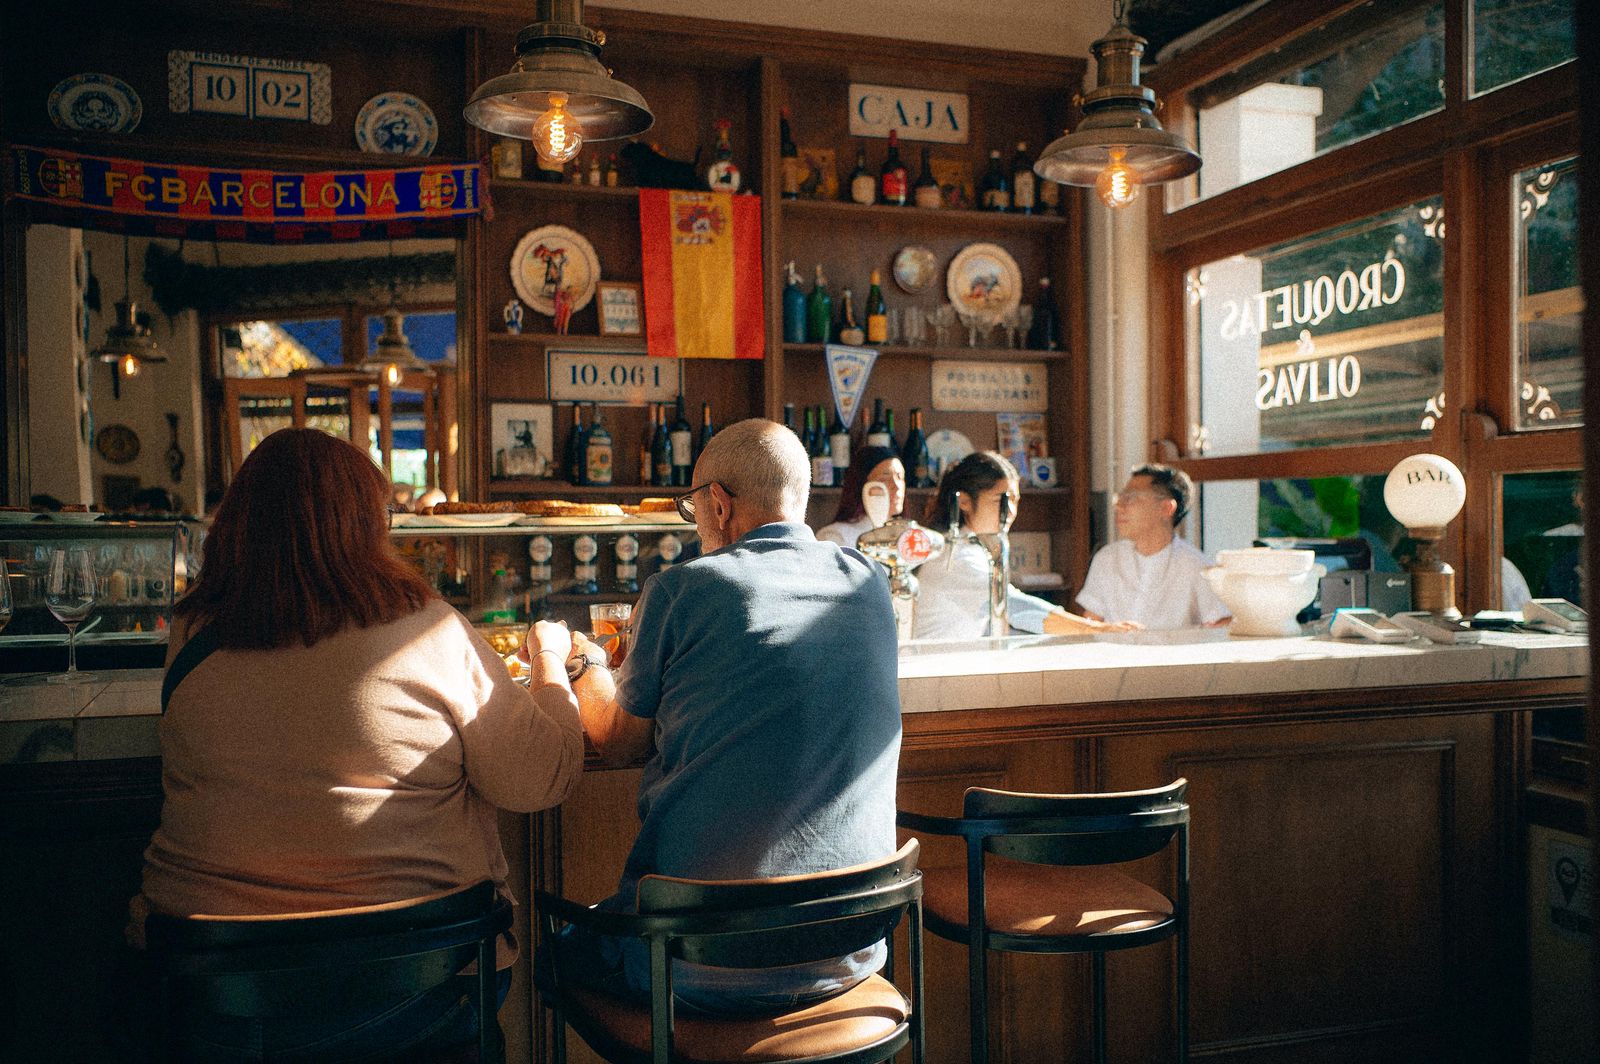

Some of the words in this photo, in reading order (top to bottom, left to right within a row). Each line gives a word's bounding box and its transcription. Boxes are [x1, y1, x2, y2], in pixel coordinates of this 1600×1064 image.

[206, 75, 237, 101] 10
[261, 80, 302, 107] 02
[858, 95, 960, 131] CAJA
[1407, 470, 1452, 485] BAR
